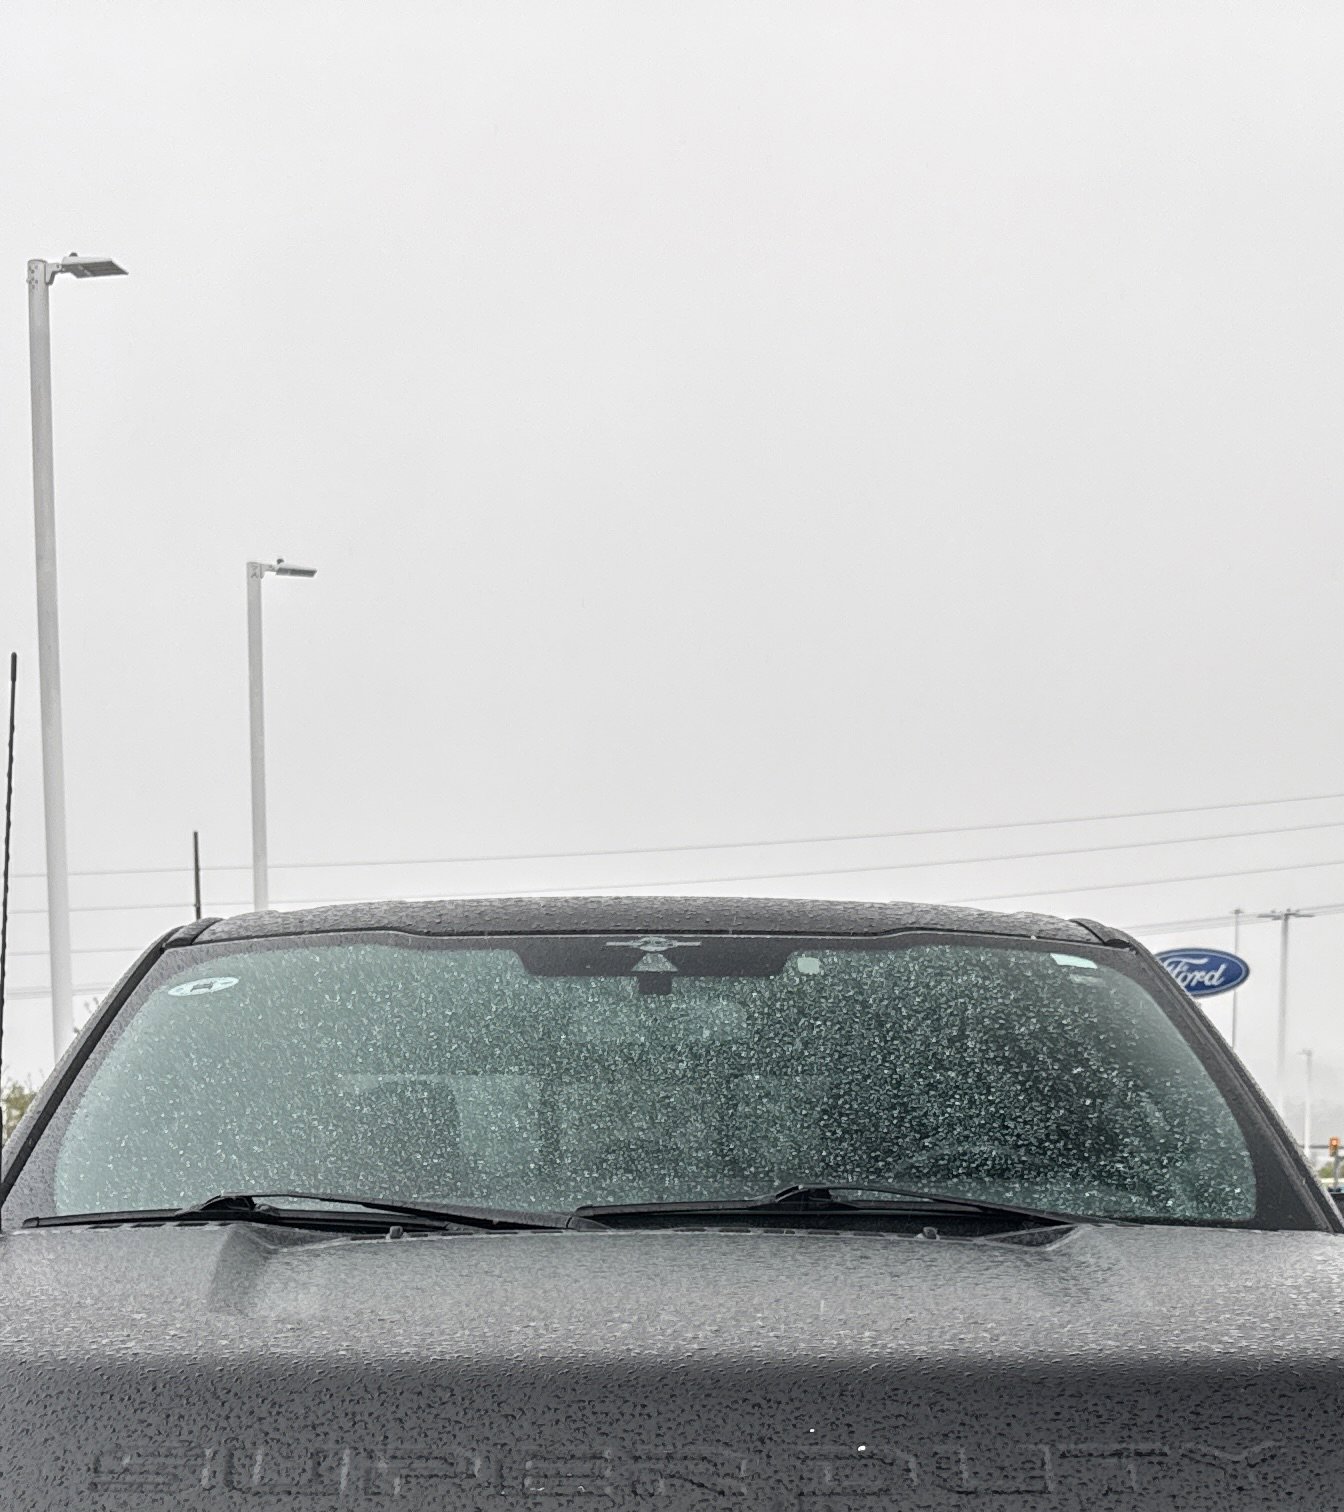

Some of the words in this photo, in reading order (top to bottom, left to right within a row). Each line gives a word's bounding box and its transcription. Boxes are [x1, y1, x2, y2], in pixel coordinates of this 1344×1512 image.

[1163, 957, 1227, 987] Ford
[90, 1446, 749, 1498] SUPER
[793, 1441, 1276, 1497] DUTY
